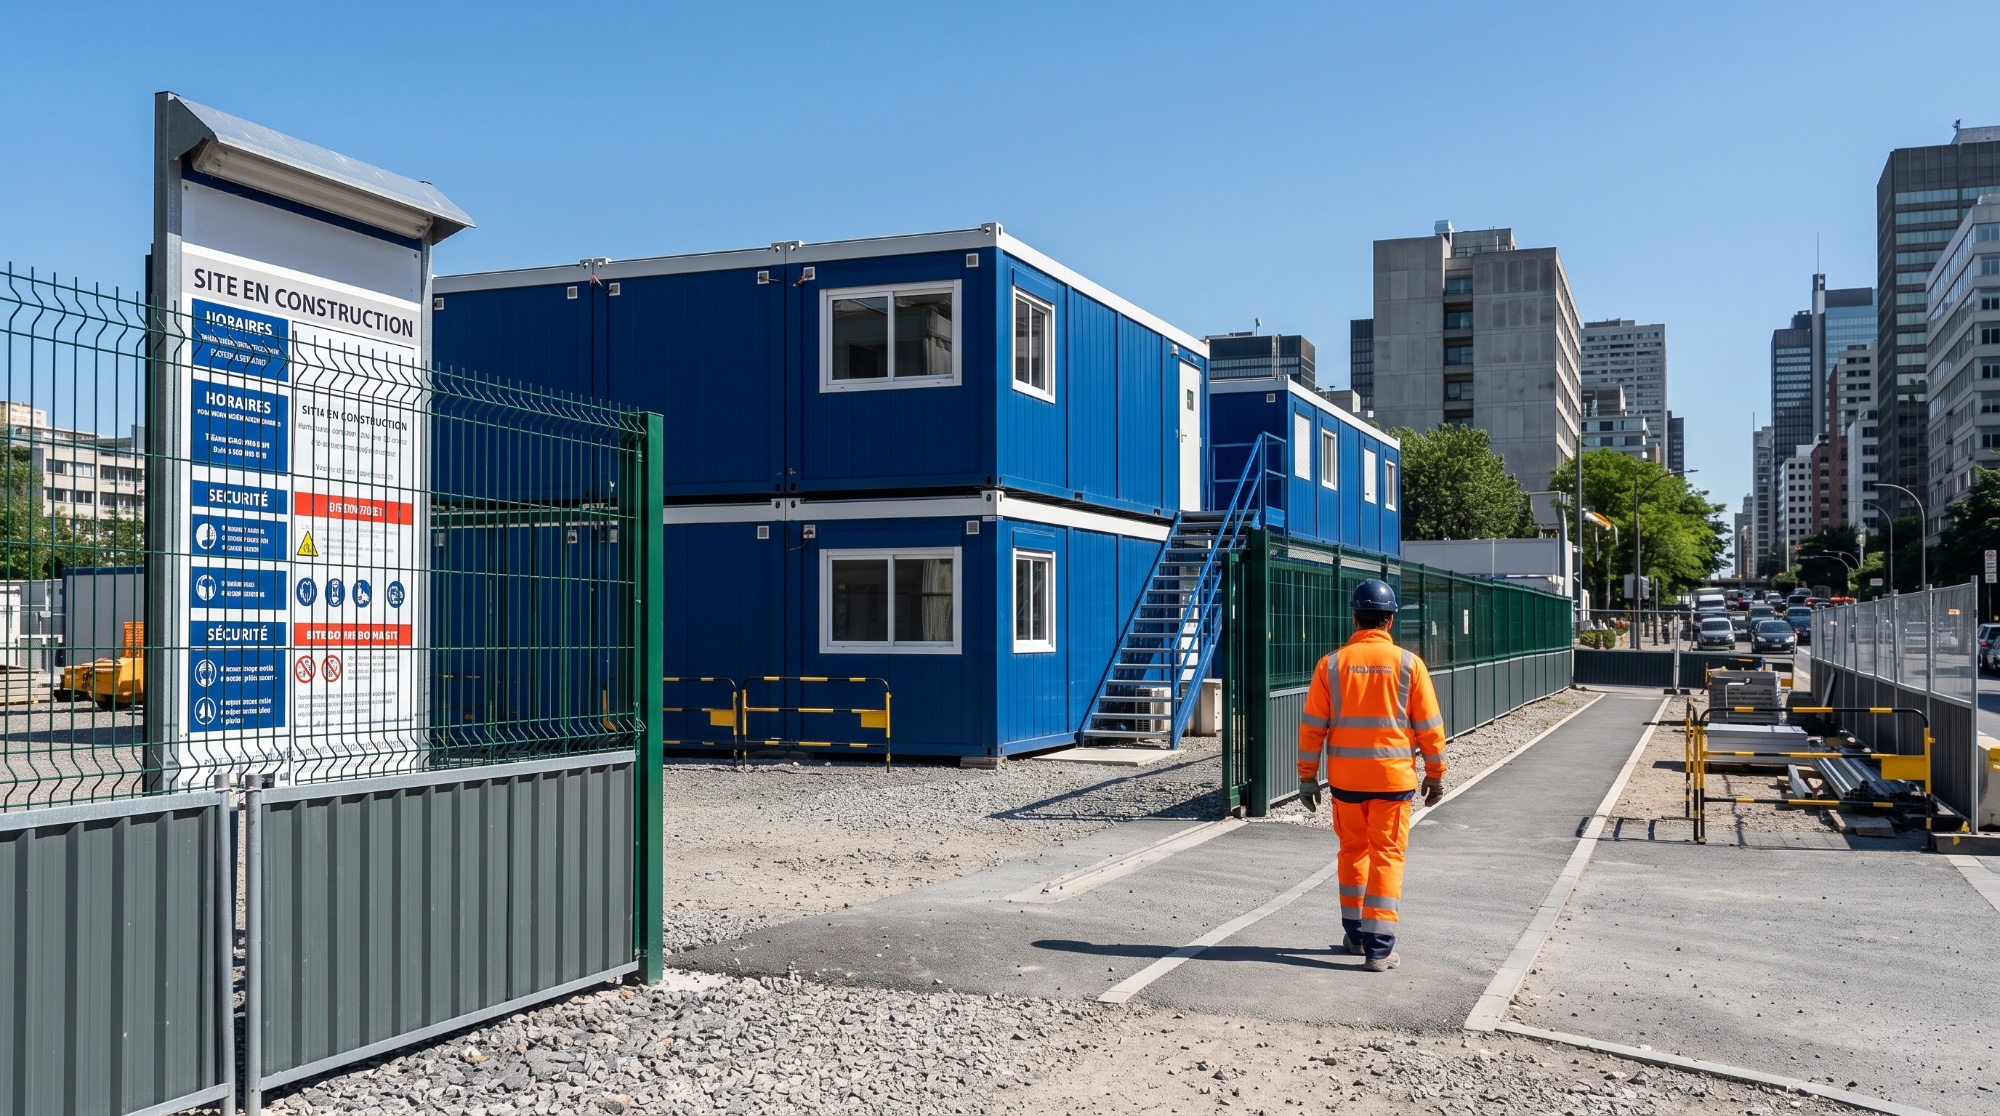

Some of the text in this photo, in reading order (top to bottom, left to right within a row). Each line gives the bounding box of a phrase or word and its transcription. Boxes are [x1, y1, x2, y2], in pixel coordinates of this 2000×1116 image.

[194, 268, 413, 338] SITE EN CONSTRUCTION
[205, 391, 271, 414] HORAIRES
[340, 412, 408, 431] CONSTRUCTION
[207, 624, 268, 641] SÉCURITÉ
